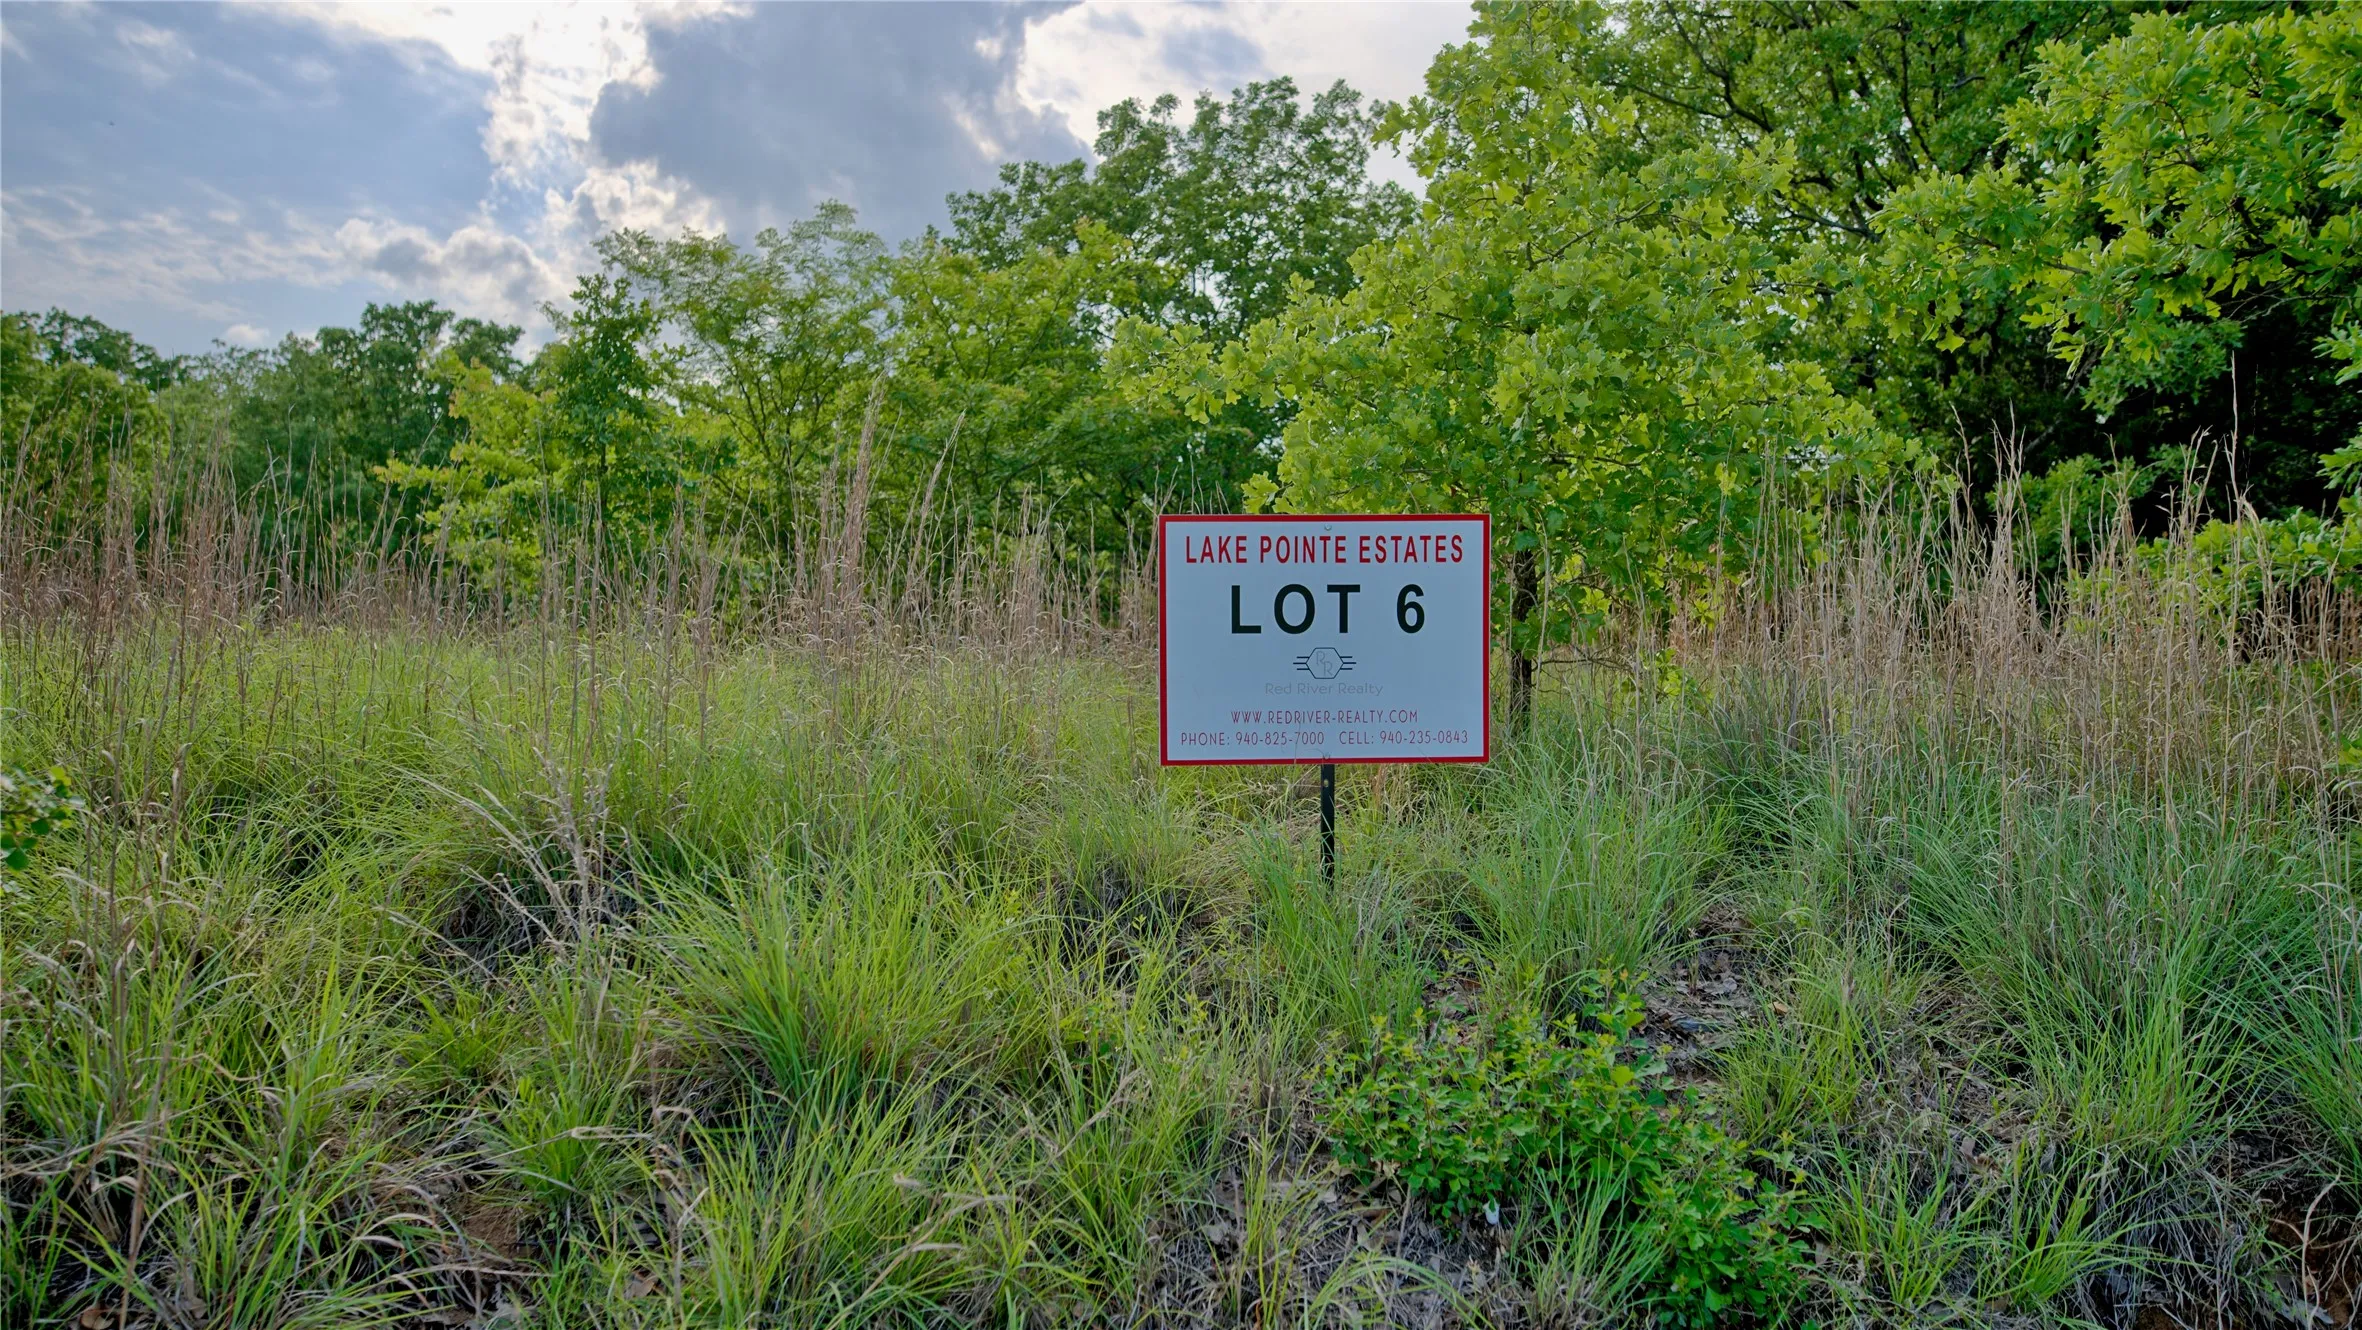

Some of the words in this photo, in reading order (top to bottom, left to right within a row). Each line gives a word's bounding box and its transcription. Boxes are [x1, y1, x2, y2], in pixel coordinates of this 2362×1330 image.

[1186, 535, 1247, 563] LAKE
[1260, 535, 1346, 563] POINTE
[1359, 534, 1463, 563] ESTATES
[1231, 583, 1361, 634] LOT
[1396, 583, 1425, 634] 6
[1265, 682, 1292, 695] Red
[1297, 682, 1333, 695] River
[1339, 682, 1383, 697] Realty
[1231, 709, 1418, 724] WWW.REDRIVER-REALTY.COM
[1181, 732, 1230, 746] PHONE:
[1235, 731, 1325, 745] 940-825-7000
[1339, 731, 1374, 745] CELL:
[1379, 730, 1468, 744] 940-235-0843
